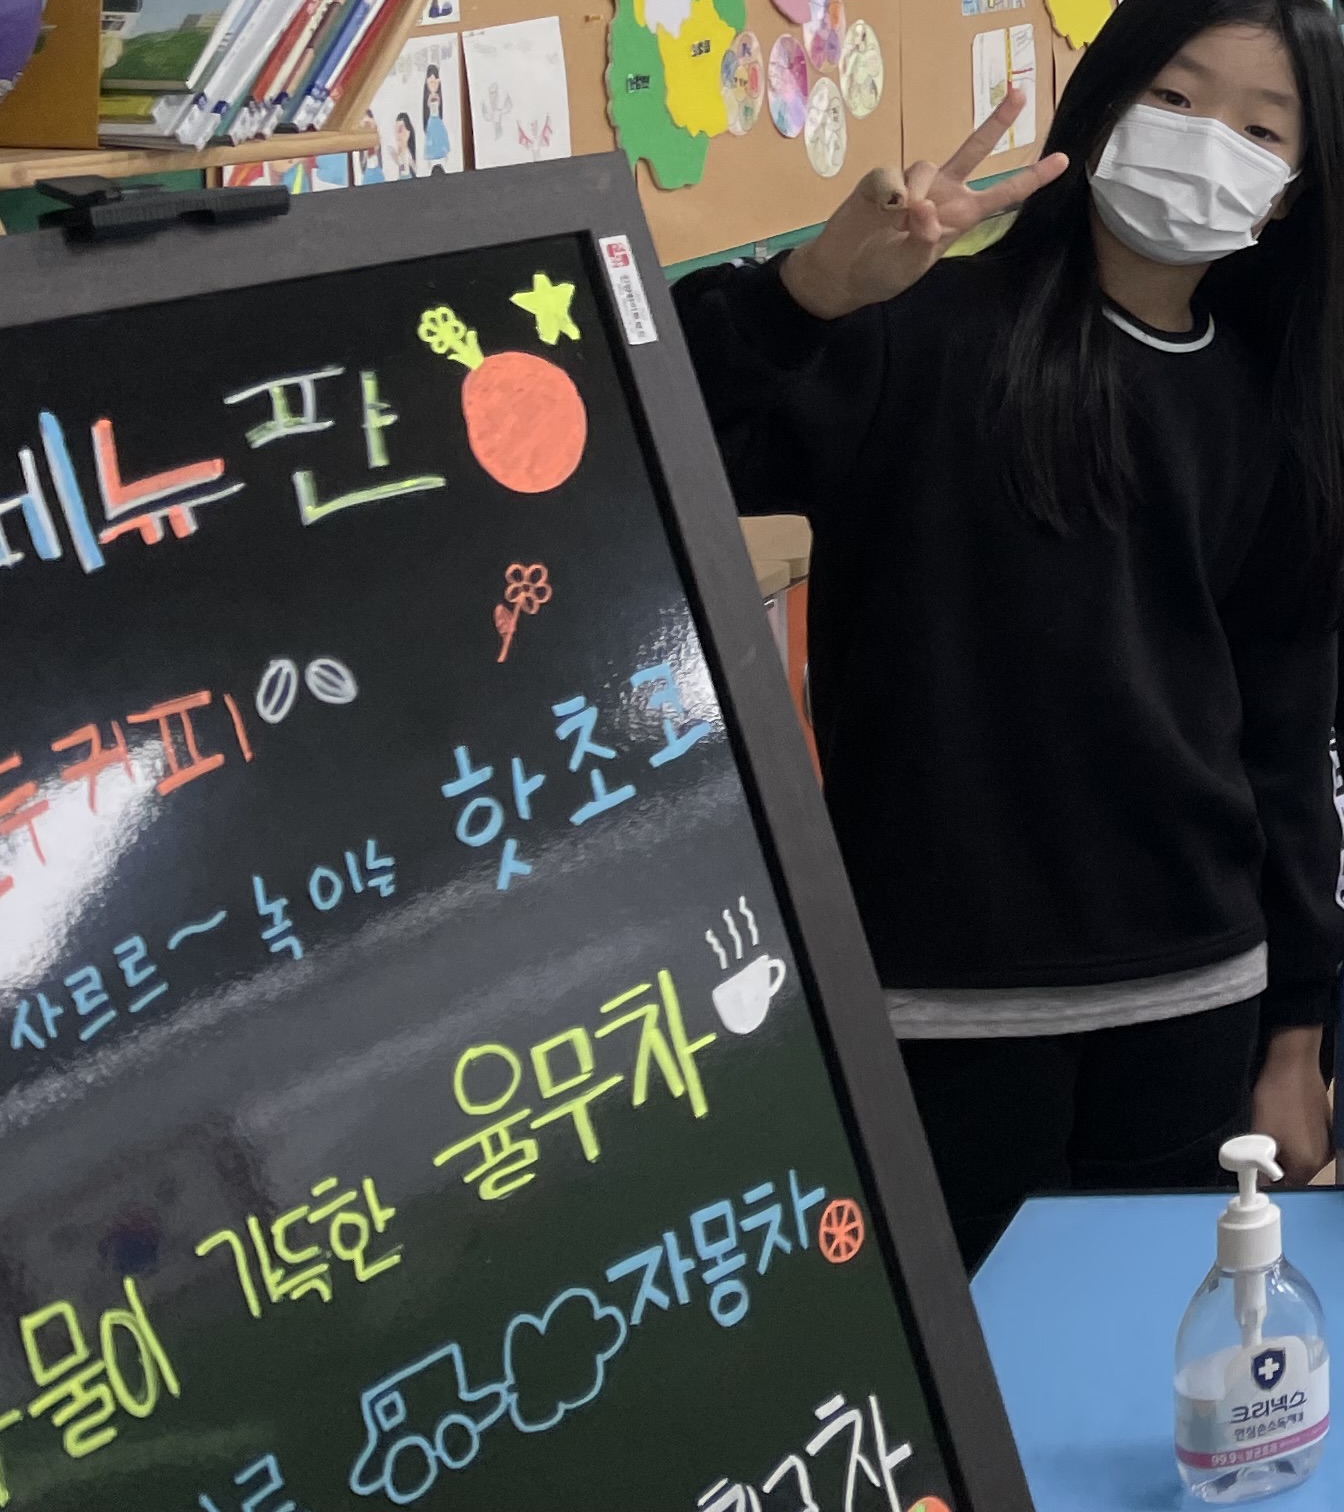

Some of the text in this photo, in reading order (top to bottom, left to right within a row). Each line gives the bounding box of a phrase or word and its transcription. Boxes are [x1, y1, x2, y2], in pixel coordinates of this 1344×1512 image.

[440, 661, 712, 892] 핫초코
[0, 1276, 181, 1458] 물이
[432, 968, 718, 1201] 율무차
[605, 1168, 826, 1329] 자몽차
[1229, 1390, 1308, 1425] 크리넥스
